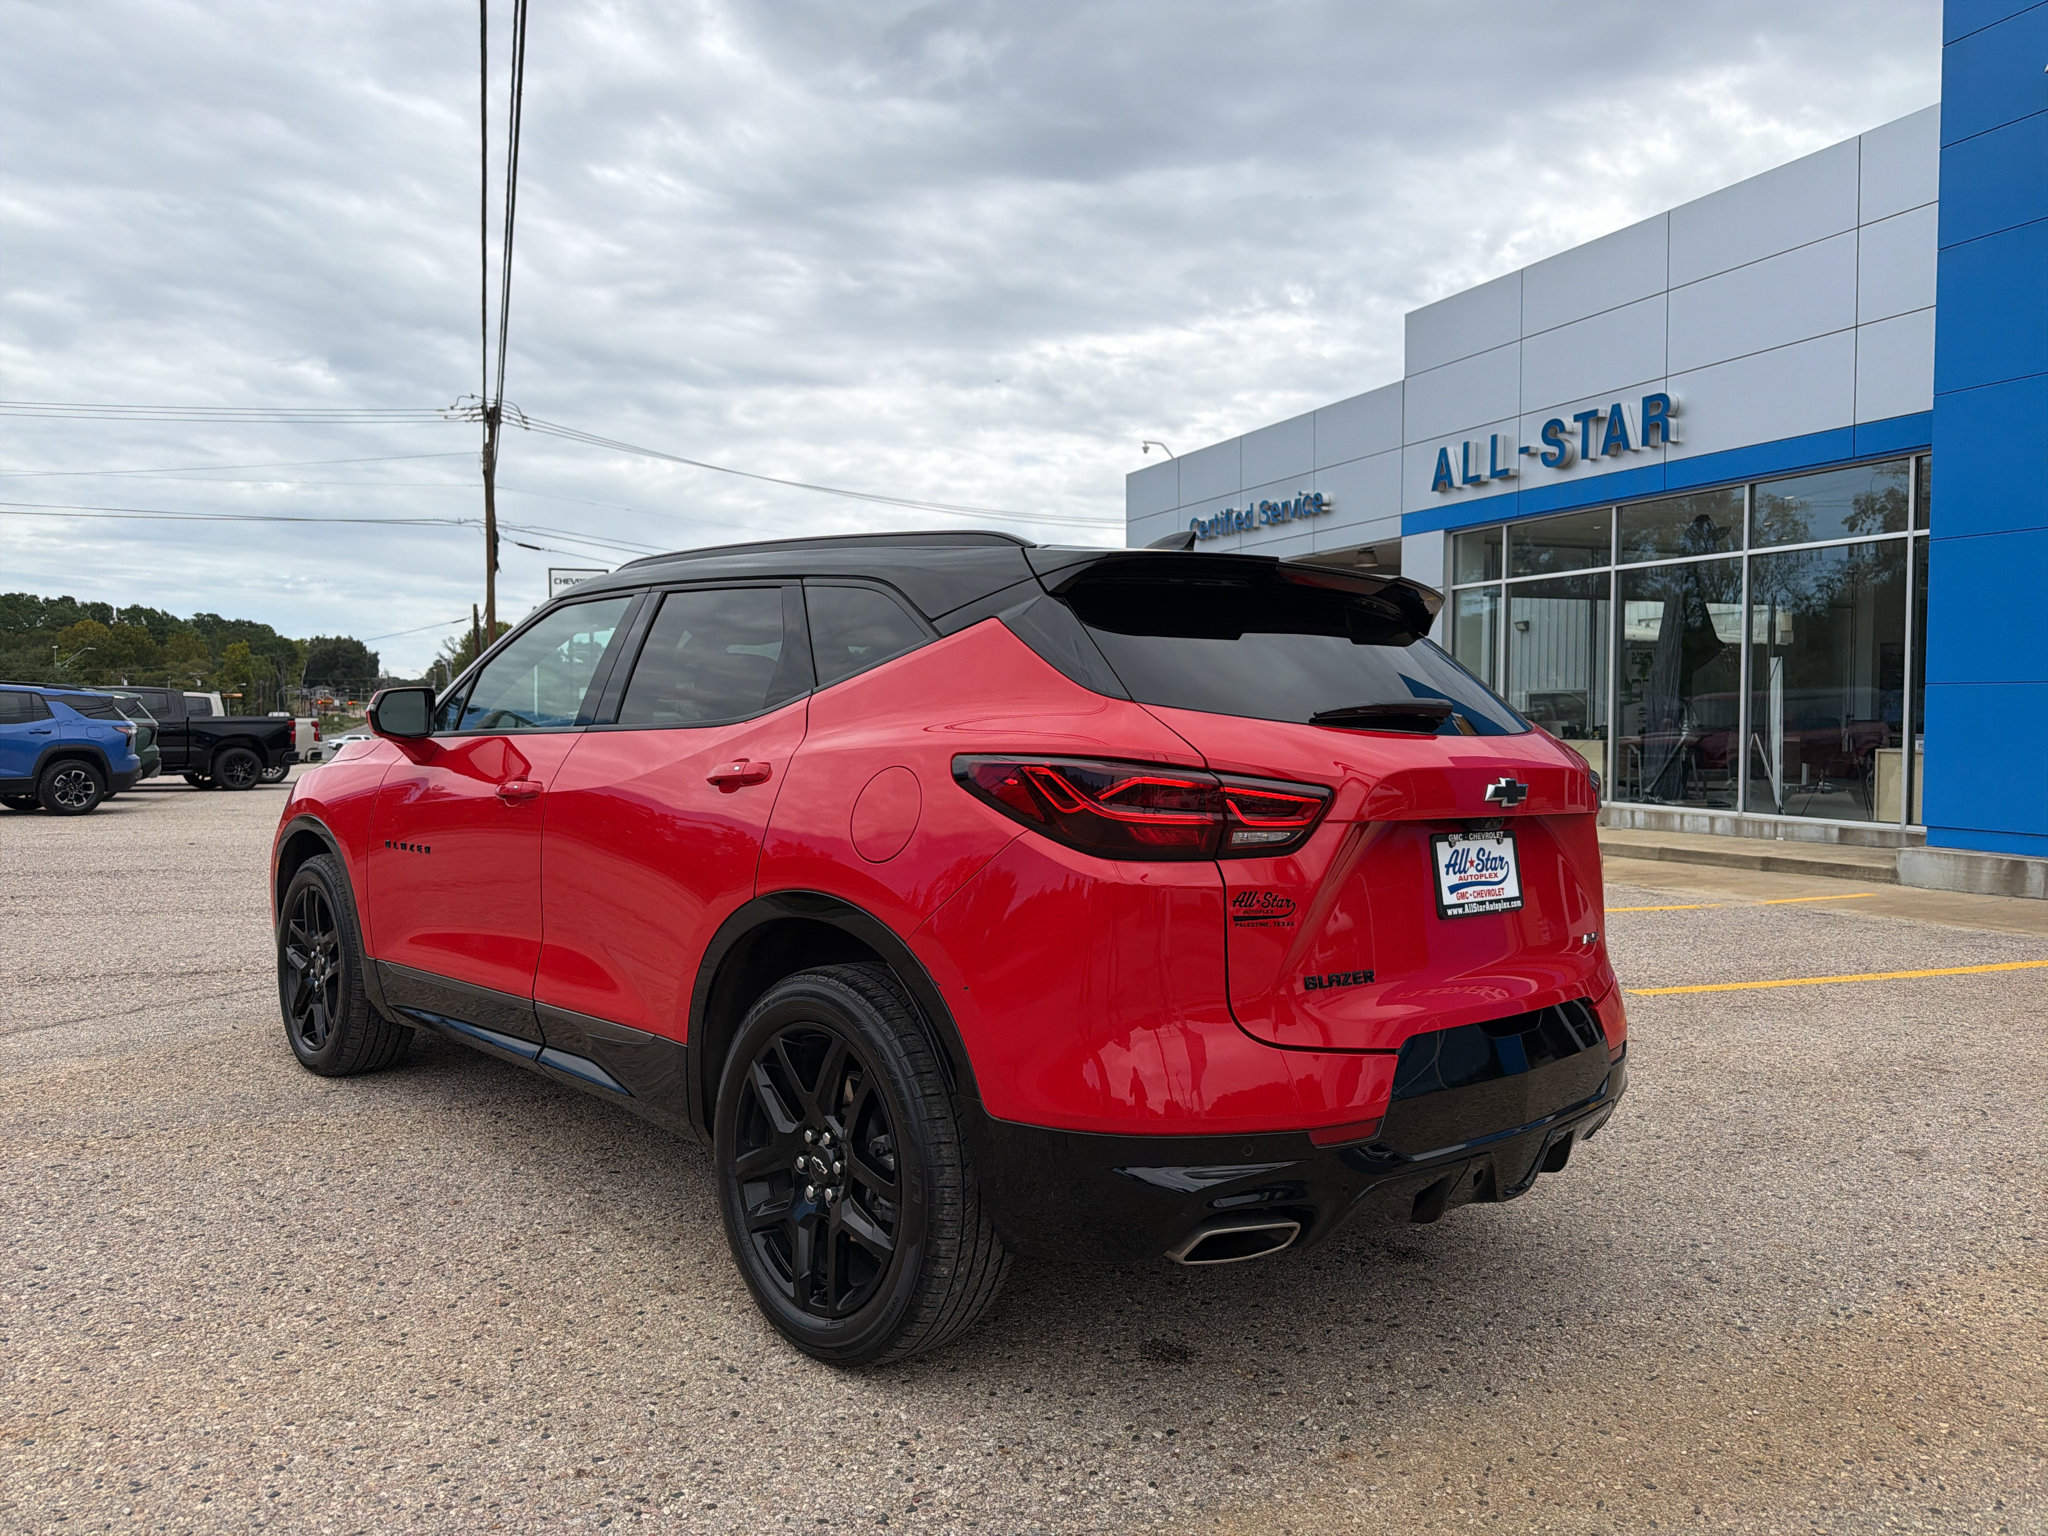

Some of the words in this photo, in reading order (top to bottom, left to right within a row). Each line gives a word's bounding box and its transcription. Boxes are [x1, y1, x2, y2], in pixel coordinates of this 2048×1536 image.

[1431, 392, 1679, 492] ALL-STAR
[1190, 502, 1254, 539] Certified
[1259, 490, 1325, 525] Service
[1448, 834, 1463, 842] GMC
[1469, 831, 1504, 840] CHEVROLET
[385, 840, 431, 854] BLAZER
[1458, 872, 1498, 882] AUTOPLEX
[1456, 891, 1470, 901] GMC
[1472, 887, 1505, 899] CHEVROLET
[1447, 900, 1522, 916] www.AllStarAutoplex.com
[1304, 969, 1375, 990] BLAZER
